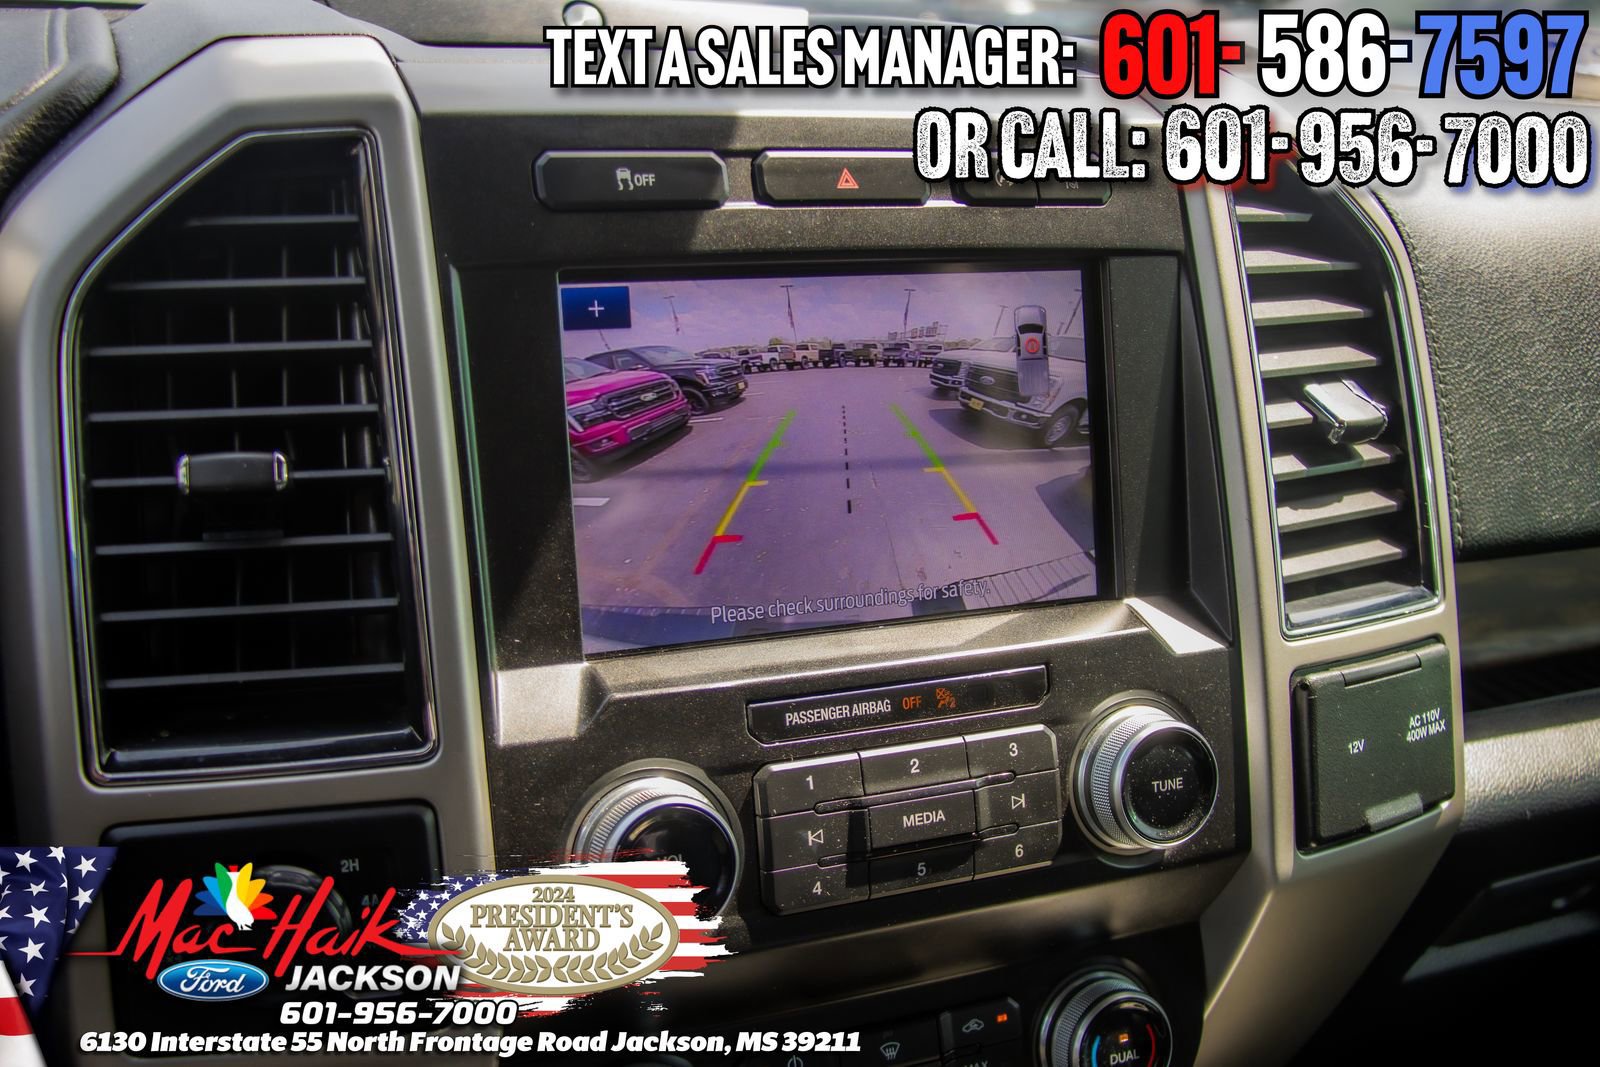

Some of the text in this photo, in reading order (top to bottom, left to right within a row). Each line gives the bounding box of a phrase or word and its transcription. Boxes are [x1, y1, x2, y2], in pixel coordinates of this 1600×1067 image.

[634, 173, 655, 187] OFF
[711, 579, 991, 624] Please check surroundings for safety.
[785, 695, 922, 726] PASSENGER AIRBAG OFF
[1409, 707, 1440, 728] AC 110V
[1406, 719, 1446, 743] 400W MAX
[1009, 742, 1019, 758] 3
[1348, 738, 1365, 755] 12V
[910, 758, 920, 774] 2
[805, 775, 814, 790] 1
[1152, 777, 1184, 793] TUNE
[902, 809, 946, 828] MEDIA
[1014, 844, 1024, 858] 6
[340, 858, 360, 873] 2H
[917, 862, 927, 876] 5
[812, 880, 822, 896] 4
[1110, 1050, 1140, 1065] DUAL
